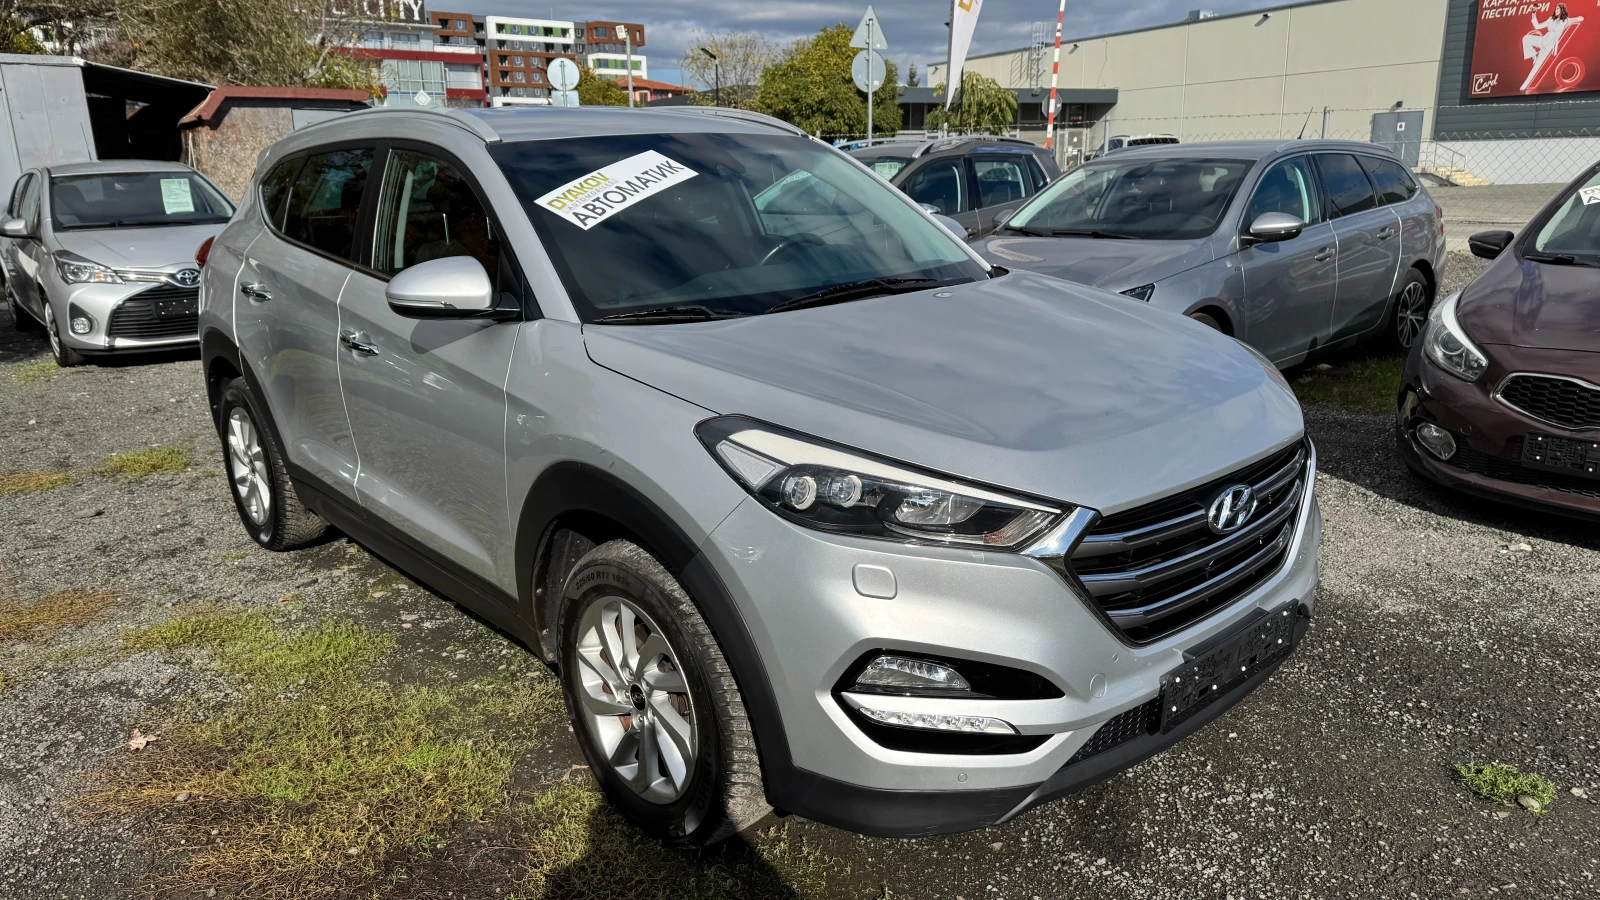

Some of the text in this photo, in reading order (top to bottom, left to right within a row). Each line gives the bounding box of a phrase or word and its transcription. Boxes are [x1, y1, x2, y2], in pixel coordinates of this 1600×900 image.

[1481, 6, 1517, 20] ПЕСТИ
[1475, 73, 1499, 92] Card
[546, 171, 610, 211] DYAKOV
[567, 181, 614, 211] AUTOMOBILES
[571, 160, 685, 227] АВТОМАТИК
[596, 571, 610, 580] R17
